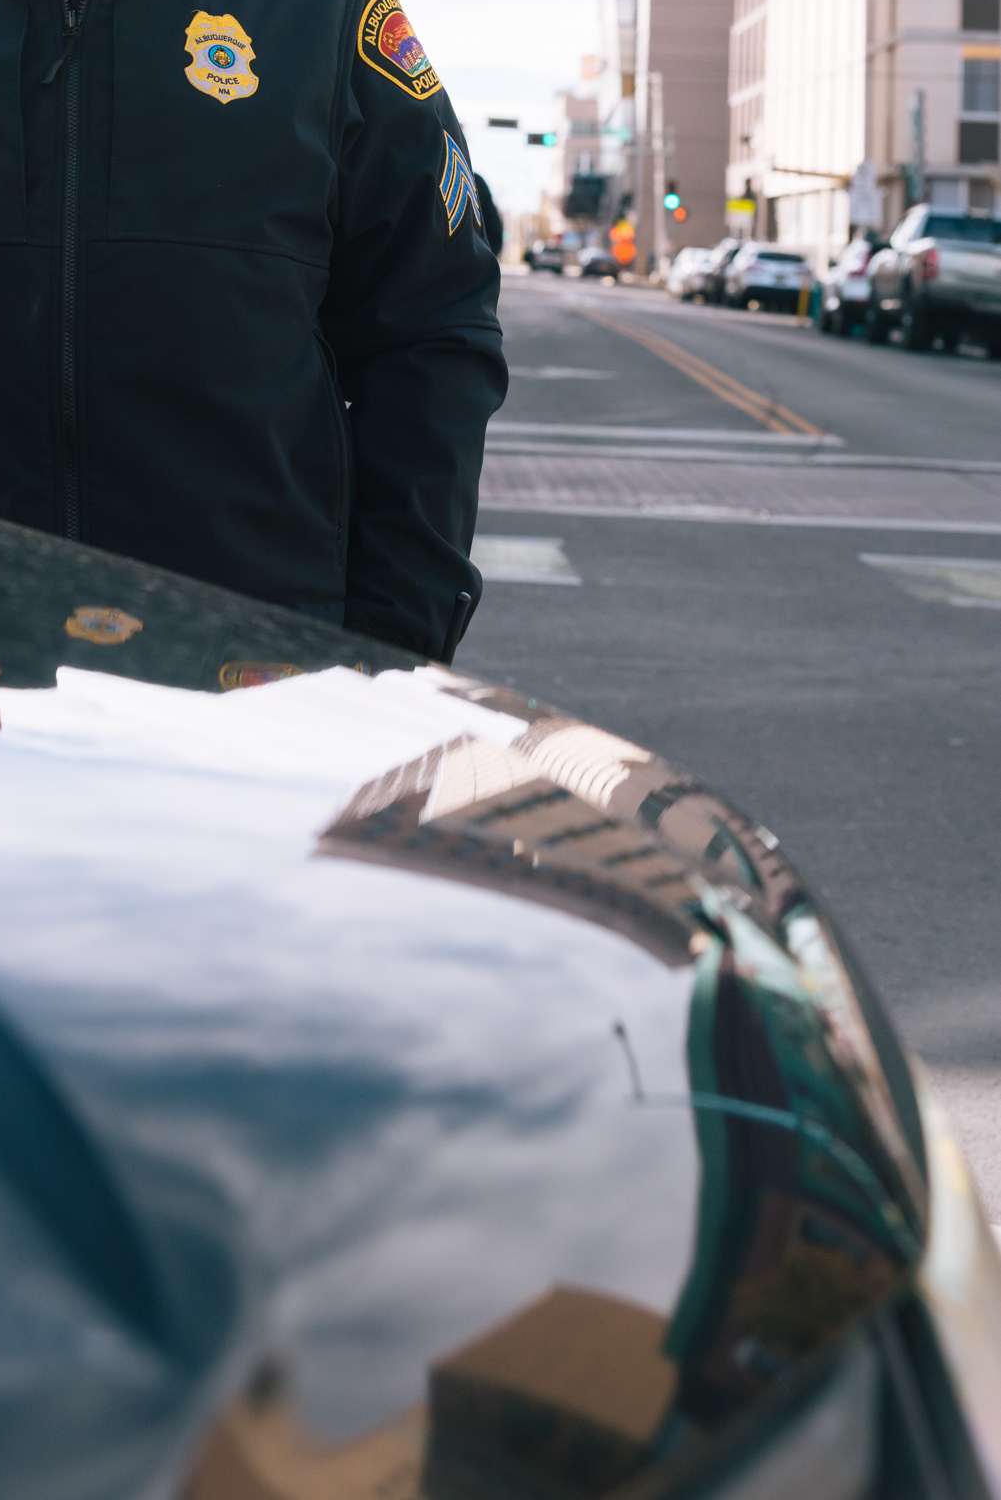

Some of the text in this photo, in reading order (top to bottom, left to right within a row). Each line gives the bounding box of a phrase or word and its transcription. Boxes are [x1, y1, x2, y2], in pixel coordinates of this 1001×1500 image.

[194, 34, 246, 50] ALBUQUERQUE
[207, 73, 240, 85] POLICE
[218, 87, 231, 95] NM
